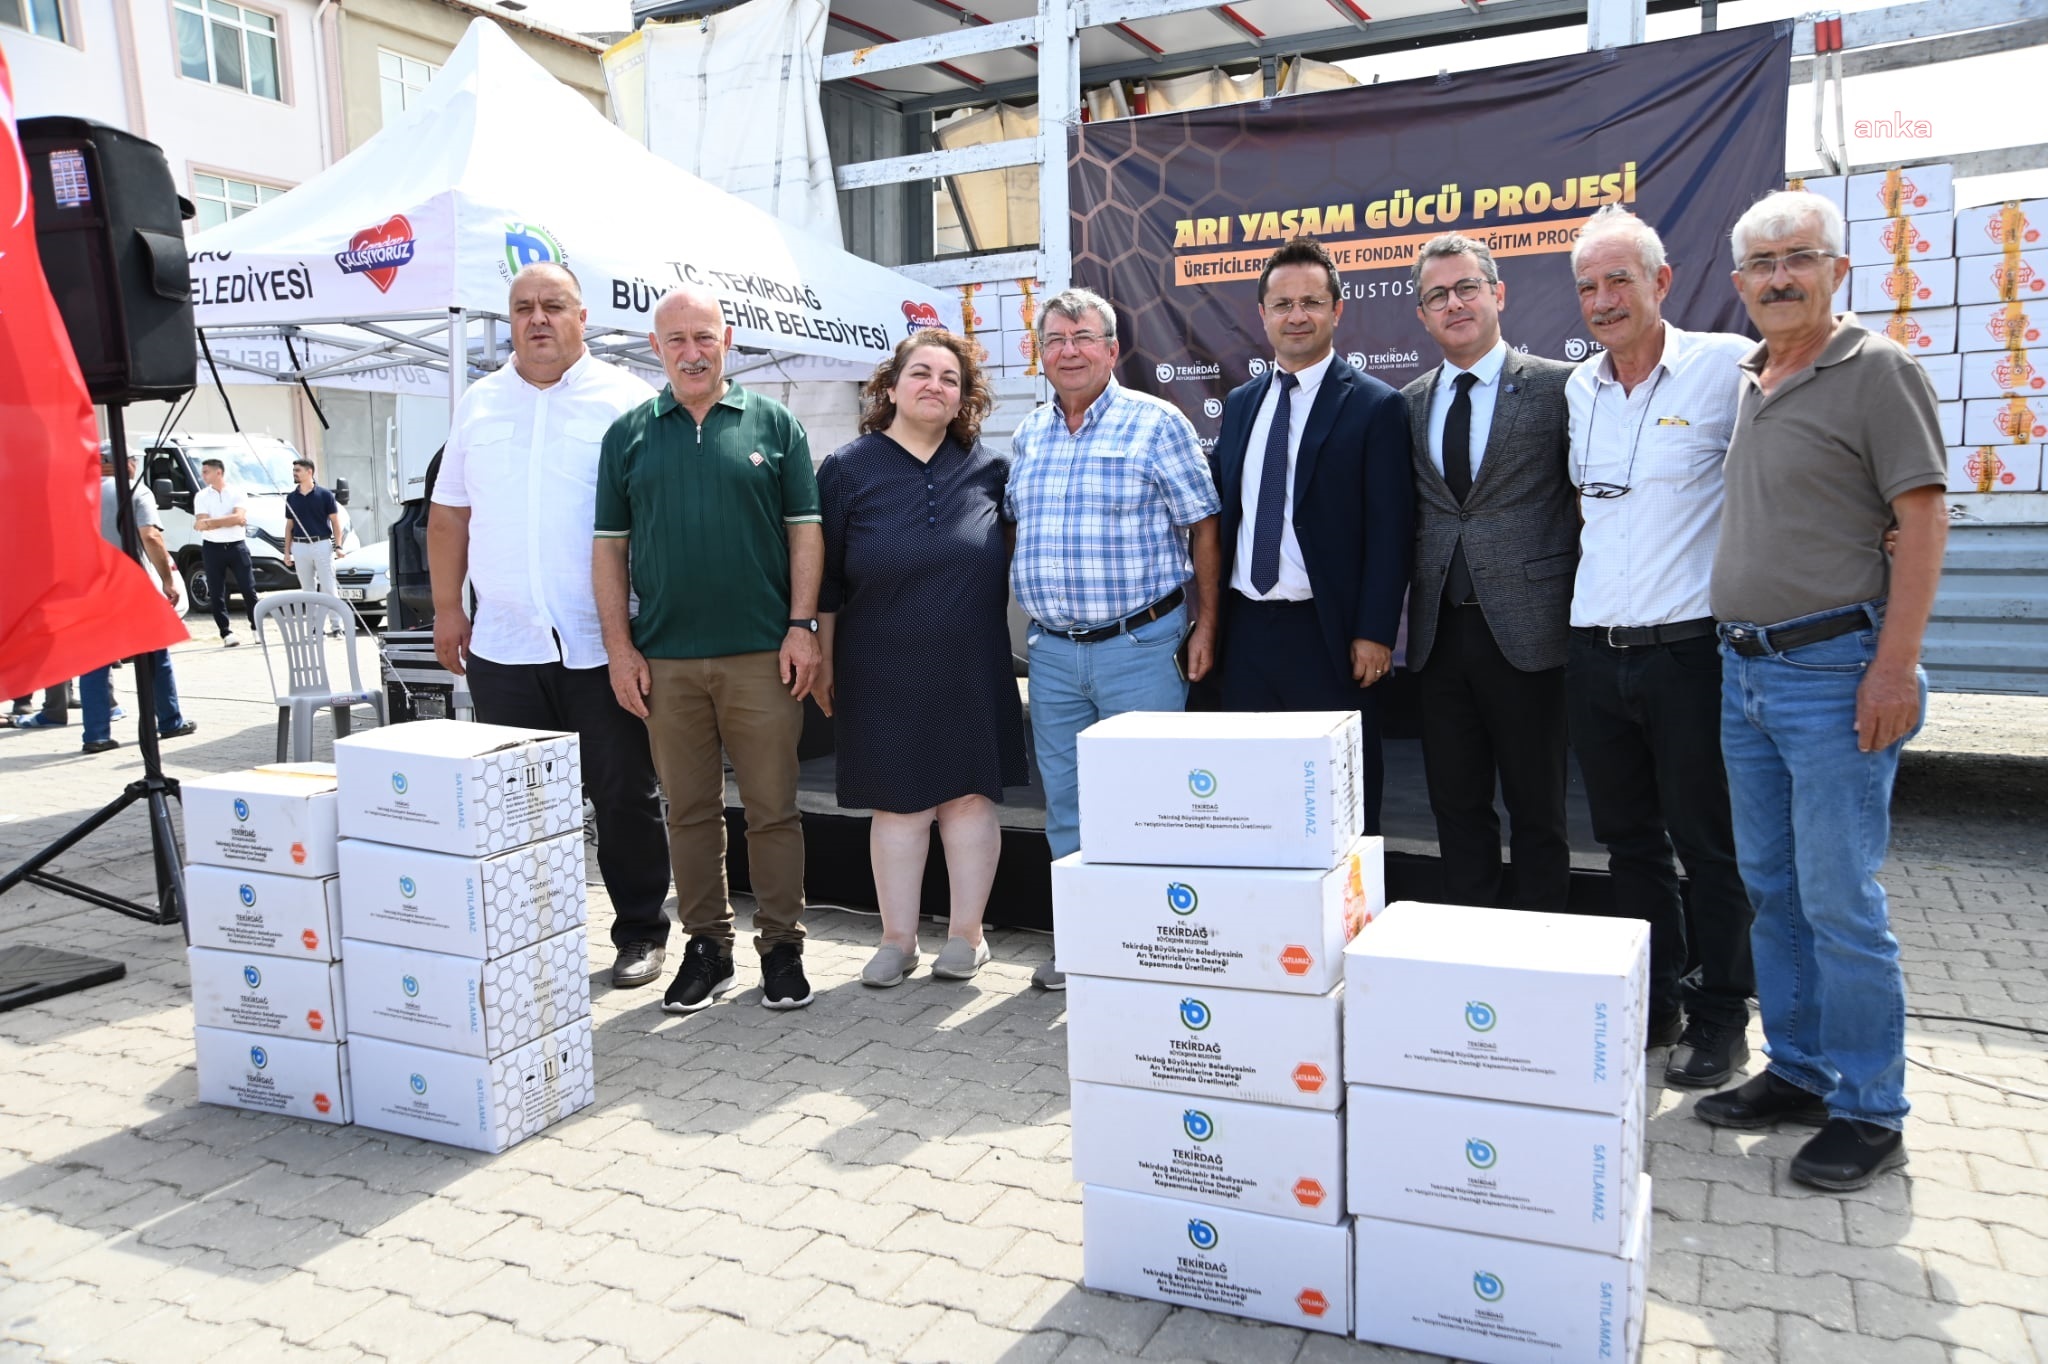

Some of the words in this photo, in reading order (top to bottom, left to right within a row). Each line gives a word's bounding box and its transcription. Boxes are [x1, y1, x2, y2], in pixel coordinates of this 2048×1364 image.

[1173, 216, 1230, 248] ARI
[1238, 203, 1355, 243] YAŞAM
[1365, 183, 1461, 229] GÜCÜ
[1472, 161, 1637, 220] PROJESİ
[338, 243, 410, 271] ÇALIŞIYORUZ
[1334, 251, 1351, 265] VE
[1355, 244, 1413, 263] FONDAN
[1472, 232, 1532, 251] AĞITIM
[1537, 228, 1580, 246] PROG
[189, 261, 314, 305] ELEDİYESİ
[708, 270, 822, 311] TEKİRDAĞ
[1341, 279, 1414, 300] ĞUSTOS
[778, 310, 890, 352] BELEDİYESİ
[1368, 350, 1419, 364] TEKİRDAĞ
[1176, 362, 1220, 375] TEKİRDAĞ
[1156, 925, 1208, 938] TEKİRDAĞ
[1169, 1040, 1221, 1053] TEKİRDAĞ
[1172, 1149, 1223, 1165] TEKİRDAĞ
[1177, 1256, 1227, 1273] TEKİRDAĞ
